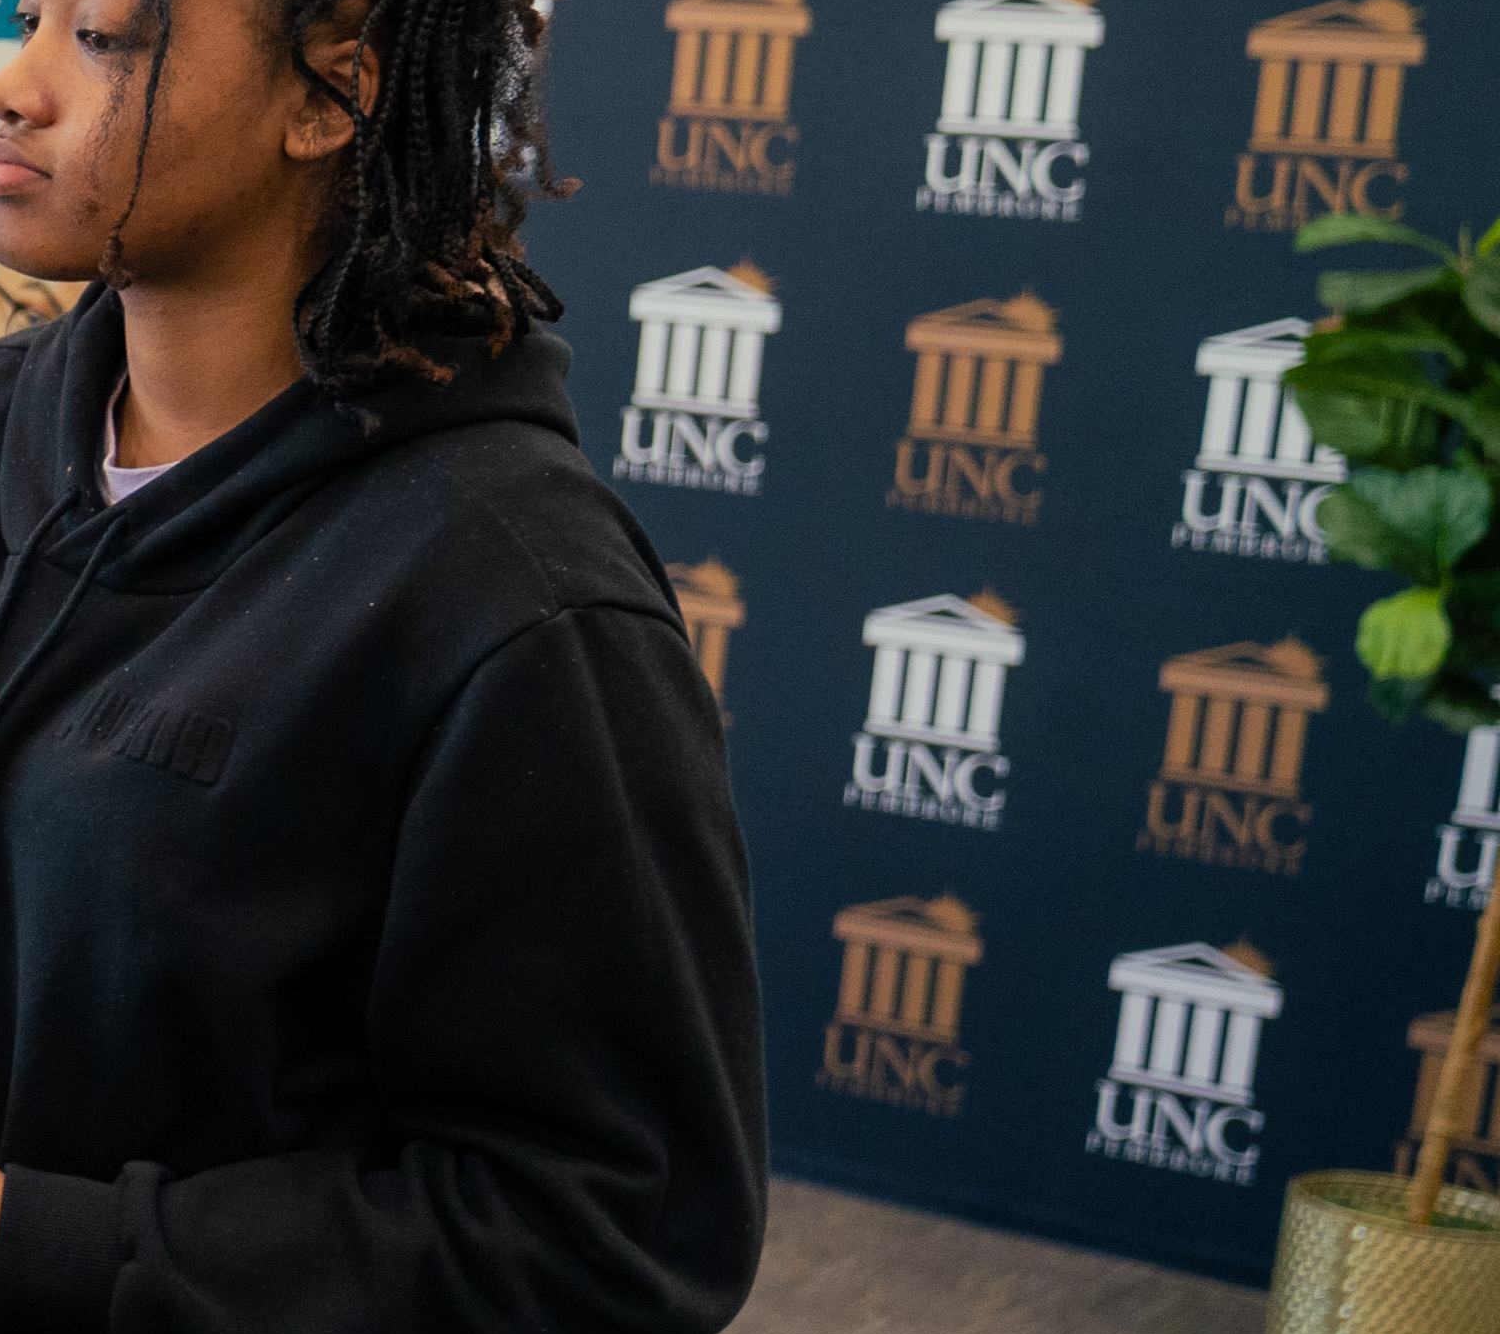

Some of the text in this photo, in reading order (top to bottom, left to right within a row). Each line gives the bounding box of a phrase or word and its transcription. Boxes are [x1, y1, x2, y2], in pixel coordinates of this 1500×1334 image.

[657, 115, 798, 171] UNC
[923, 135, 1089, 201] UNC
[1234, 159, 1408, 221] UNC
[621, 409, 768, 478] UNC
[896, 440, 1047, 509] UNC
[851, 737, 1009, 813] UNC
[1146, 786, 1311, 860] UNC
[824, 1021, 970, 1095] UNC
[1095, 1081, 1264, 1167] UNC
